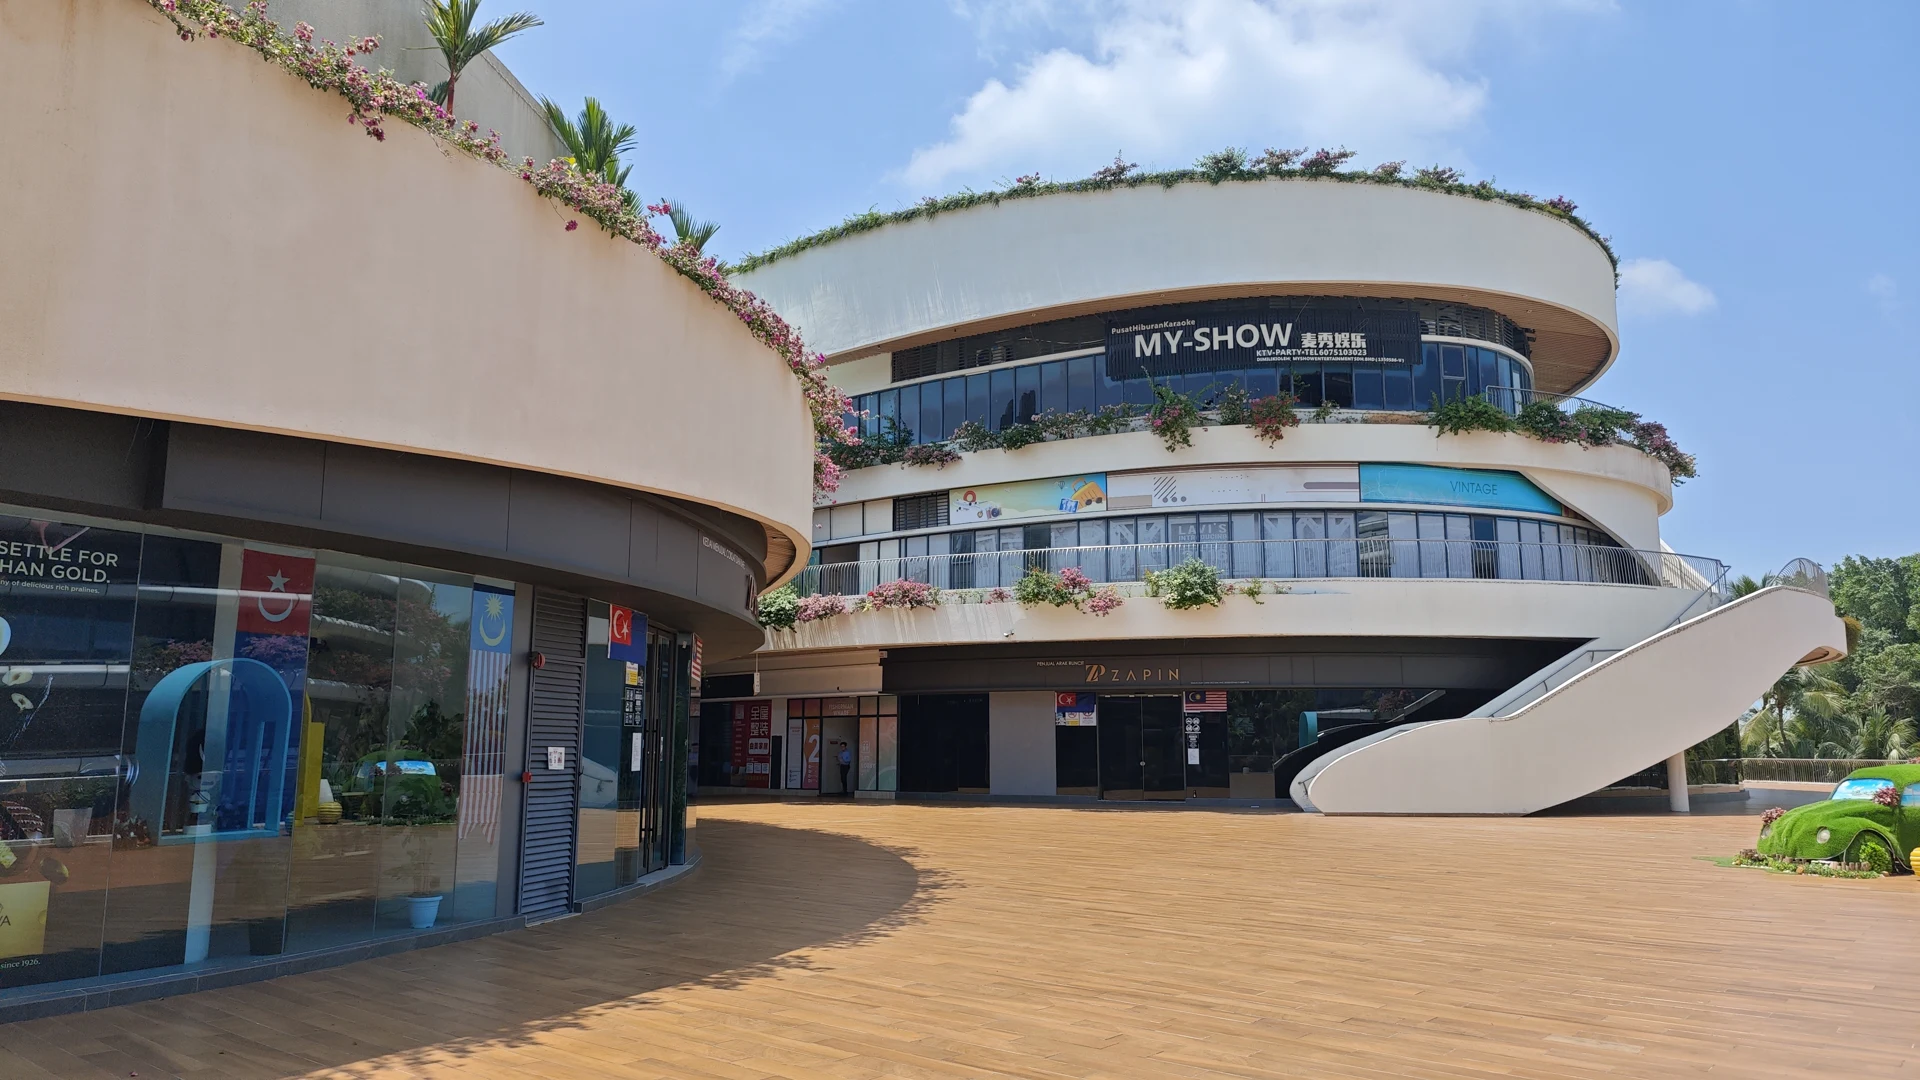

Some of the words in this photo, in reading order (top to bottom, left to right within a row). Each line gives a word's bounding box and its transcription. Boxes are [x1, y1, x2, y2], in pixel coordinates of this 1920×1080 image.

[1111, 319, 1196, 335] PusatHiburanKaraoke
[1135, 323, 1293, 358] MY-SHOW
[1301, 332, 1366, 349] 麦秀娱乐
[1450, 480, 1498, 495] VINTAGE
[0, 540, 73, 562] SETTLE
[79, 549, 118, 567] FOR
[0, 558, 45, 577] HAN
[51, 564, 111, 584] GOLD.
[21, 580, 54, 590] delicious
[70, 586, 100, 594] pralines.
[1111, 668, 1180, 682] ZAPIN
[0, 961, 20, 969] since
[21, 958, 41, 967] 1926.
